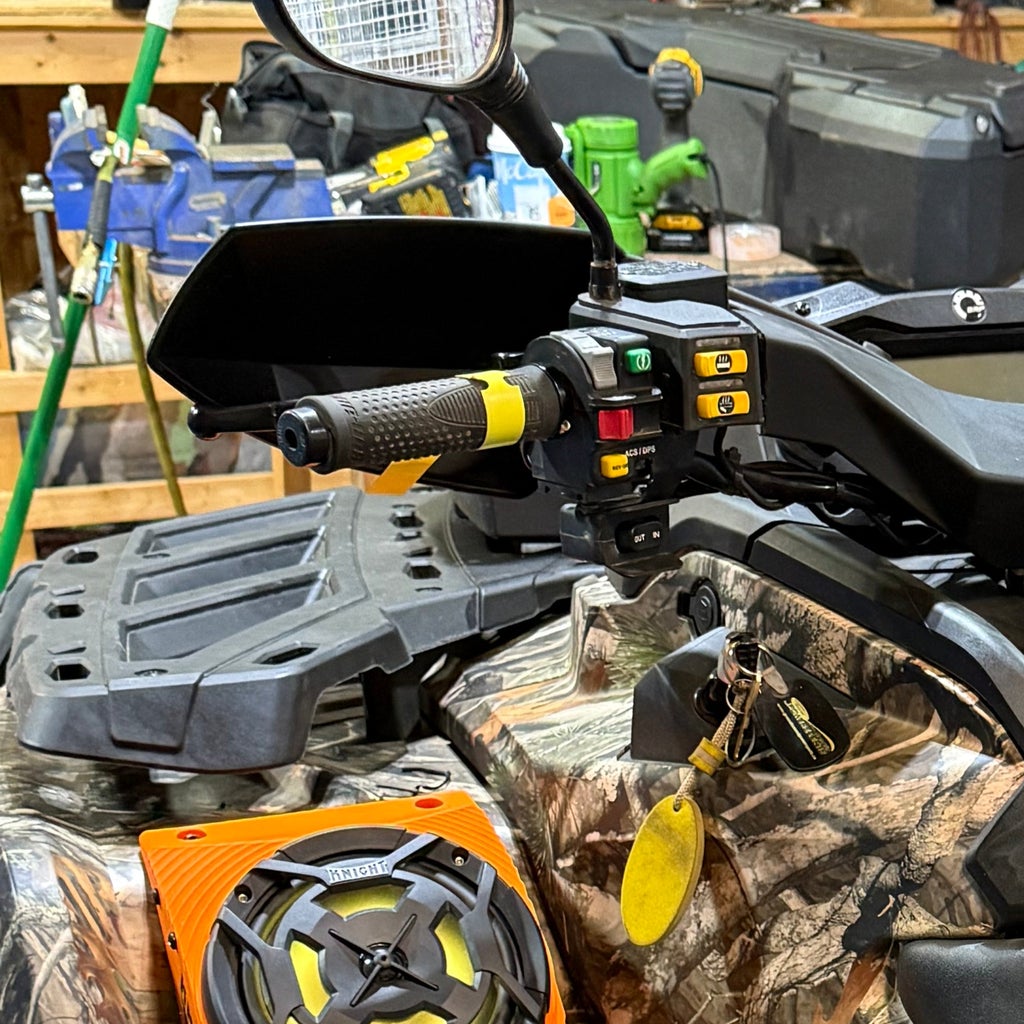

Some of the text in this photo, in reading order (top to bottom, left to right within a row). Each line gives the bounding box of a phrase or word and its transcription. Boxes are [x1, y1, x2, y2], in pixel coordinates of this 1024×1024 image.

[626, 448, 638, 456] ACS
[643, 445, 656, 453] DPS
[634, 530, 661, 543] OUT IN
[329, 860, 388, 882] KNIGHT
